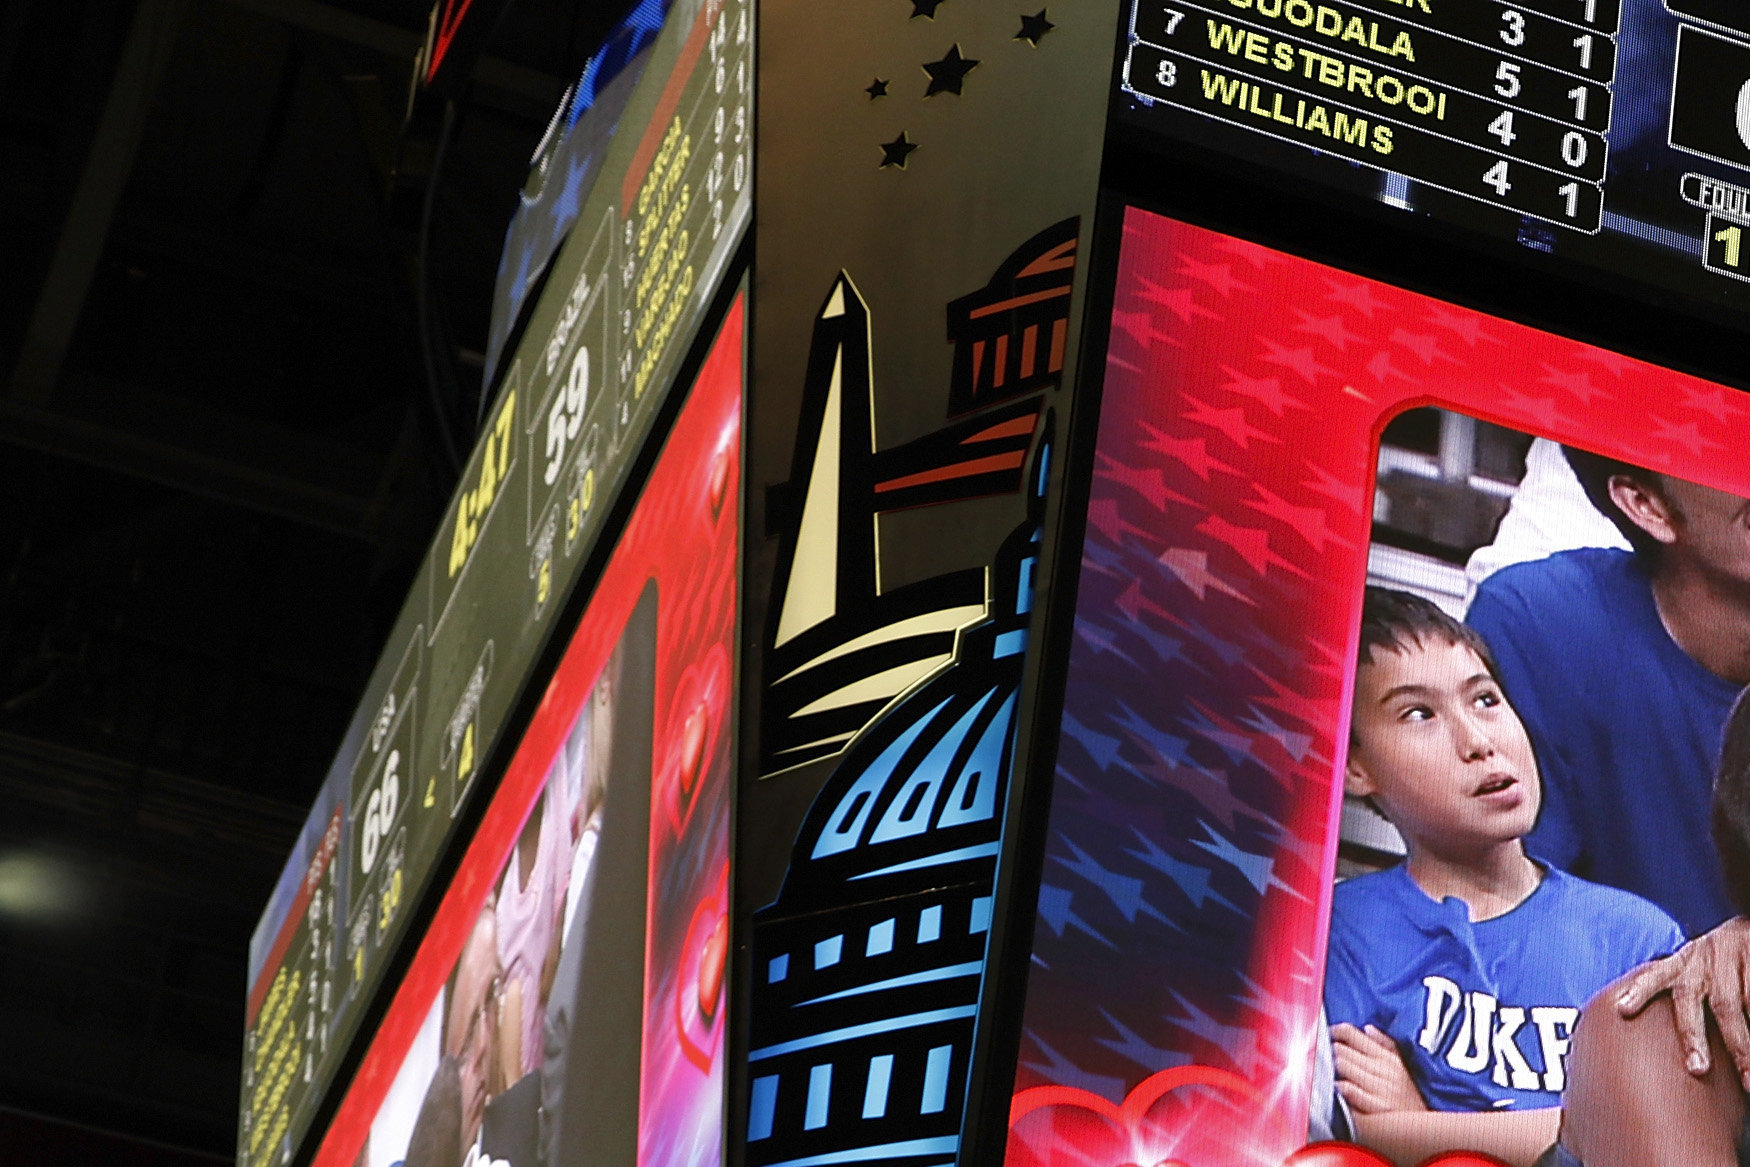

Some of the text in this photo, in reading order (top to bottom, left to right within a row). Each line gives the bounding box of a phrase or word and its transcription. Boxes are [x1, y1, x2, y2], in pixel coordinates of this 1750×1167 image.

[1163, 8, 1186, 35] 7
[1487, 111, 1517, 146] 4
[1561, 131, 1588, 167] 0
[1494, 61, 1521, 98] 5
[1567, 86, 1588, 121] 1
[1499, 10, 1594, 70] 3 1
[1155, 59, 1580, 217] 8 WILLIAMS 4 1
[1714, 227, 1741, 268] 1
[545, 346, 589, 485] 59
[449, 389, 516, 580] 4:47
[361, 749, 399, 874] 66
